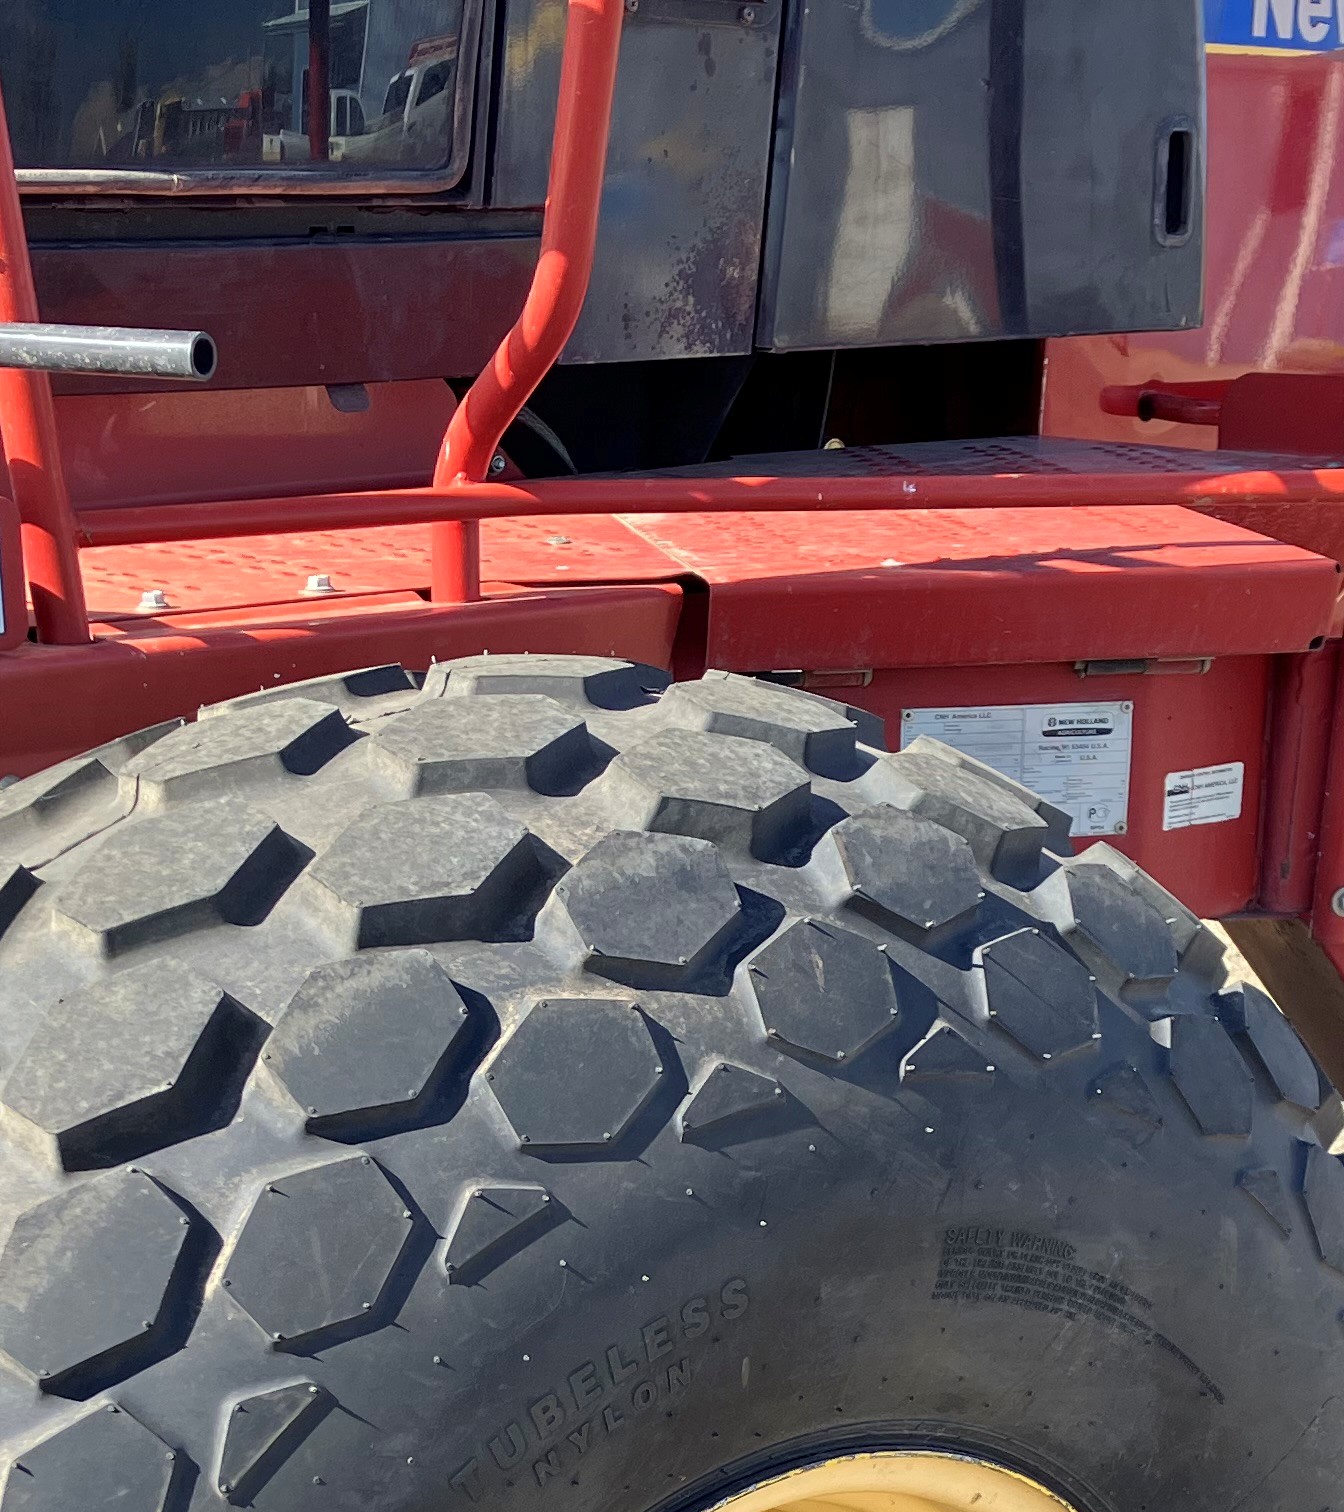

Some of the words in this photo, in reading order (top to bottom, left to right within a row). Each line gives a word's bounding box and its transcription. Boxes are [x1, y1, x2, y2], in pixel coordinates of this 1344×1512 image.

[1076, 717, 1109, 725] HOLLAND
[945, 1227, 1006, 1248] SAFETY
[1009, 1230, 1077, 1261] WARNING
[448, 1277, 752, 1503] TUBELESS
[532, 1356, 692, 1487] NYLON
